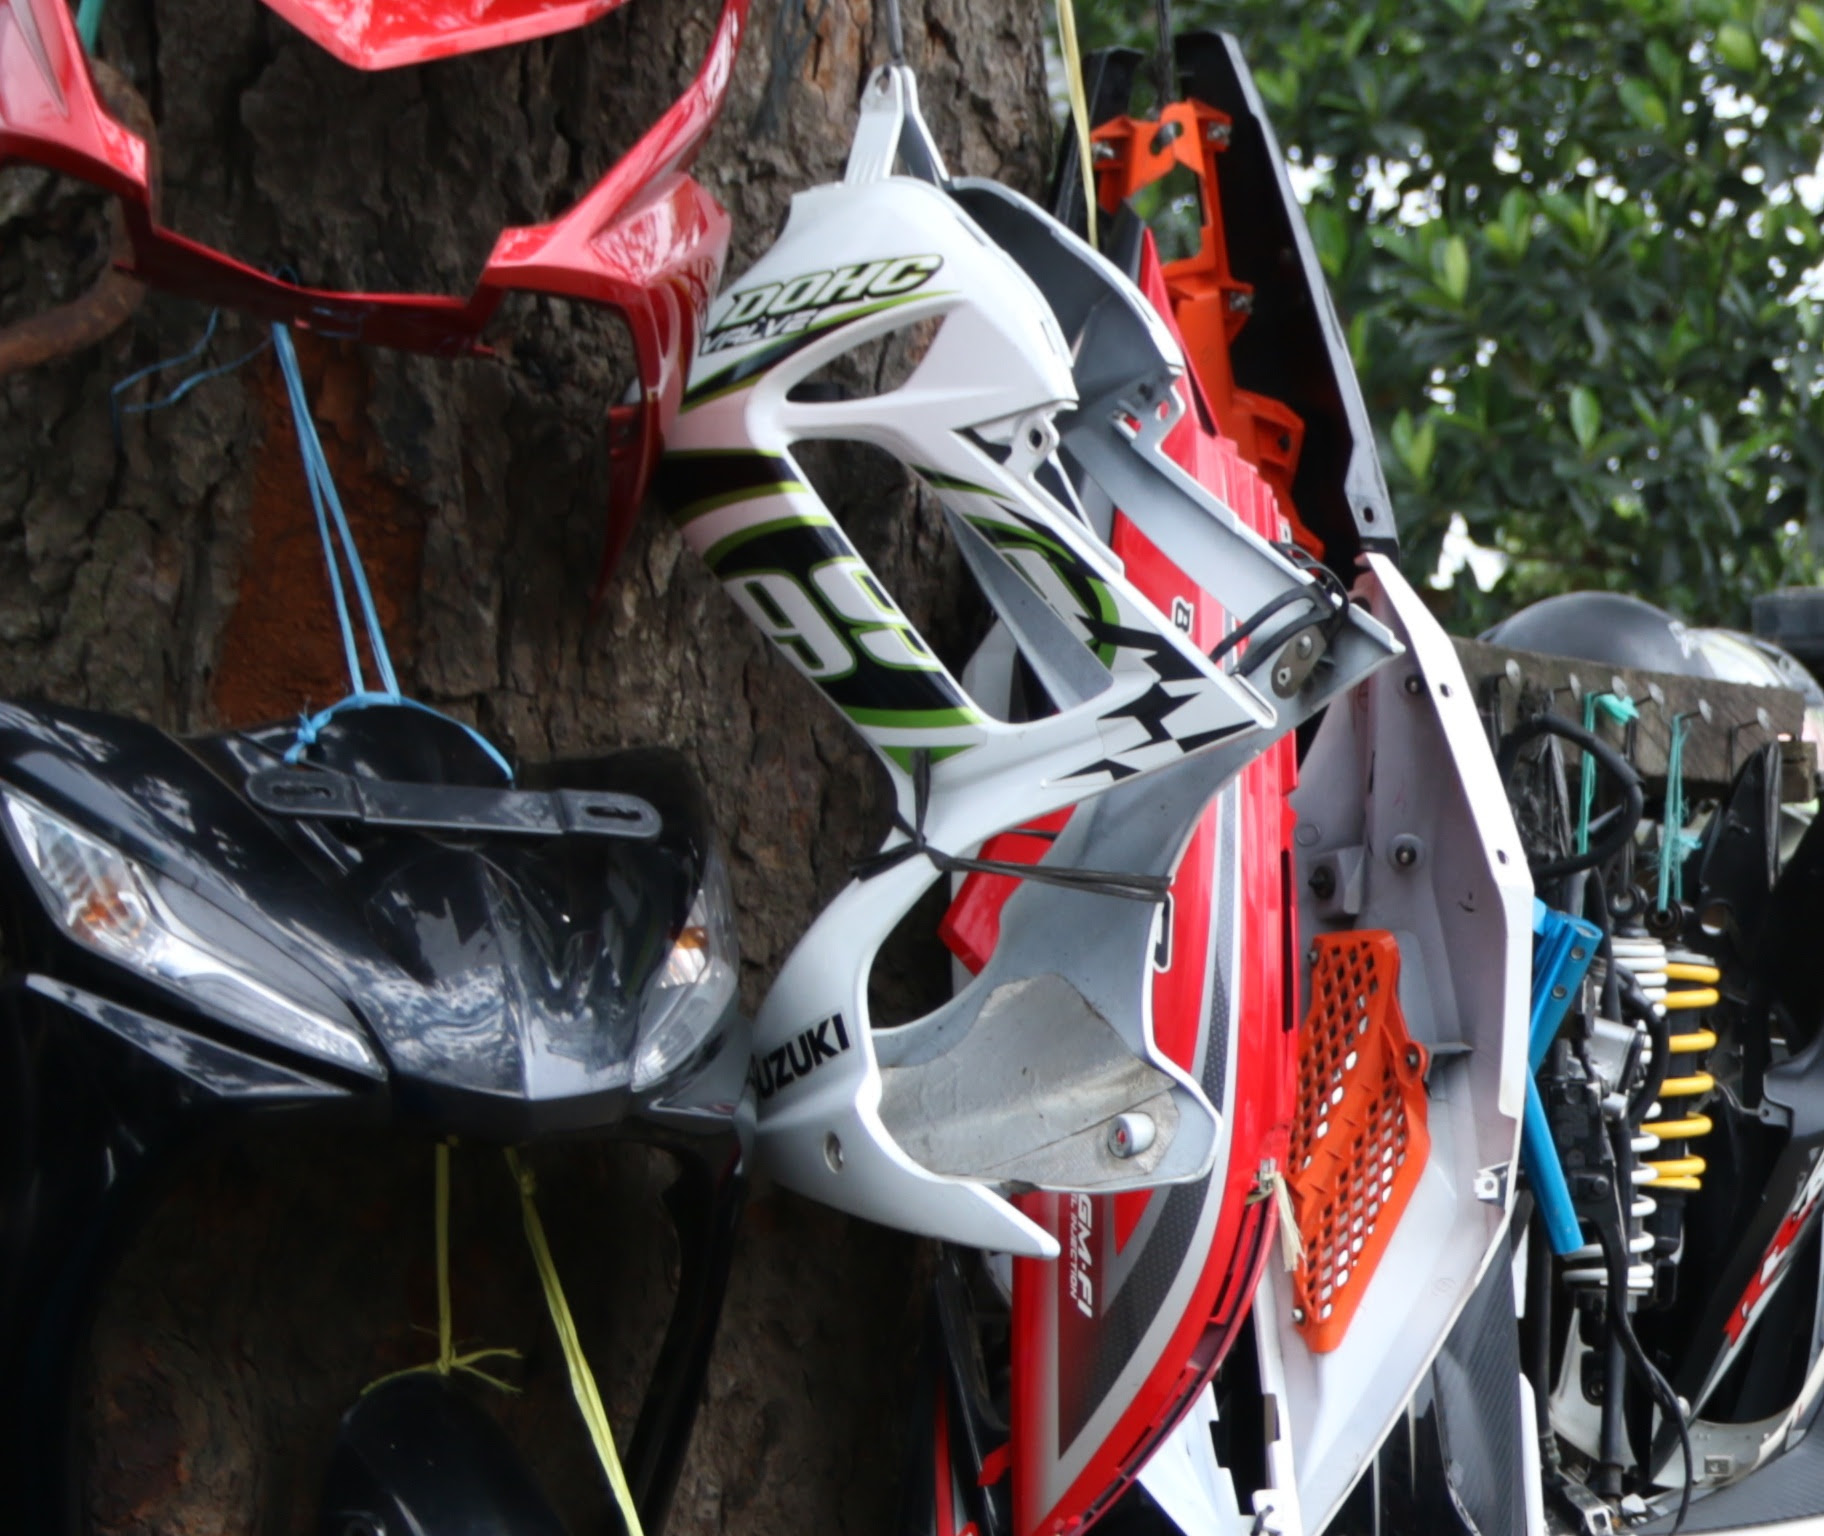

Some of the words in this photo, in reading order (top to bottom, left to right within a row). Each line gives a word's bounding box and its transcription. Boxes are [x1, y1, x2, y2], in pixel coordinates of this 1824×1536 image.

[717, 254, 944, 328] DOHC
[749, 1013, 851, 1100] UZUKI
[1069, 1211, 1079, 1301] INJECTION
